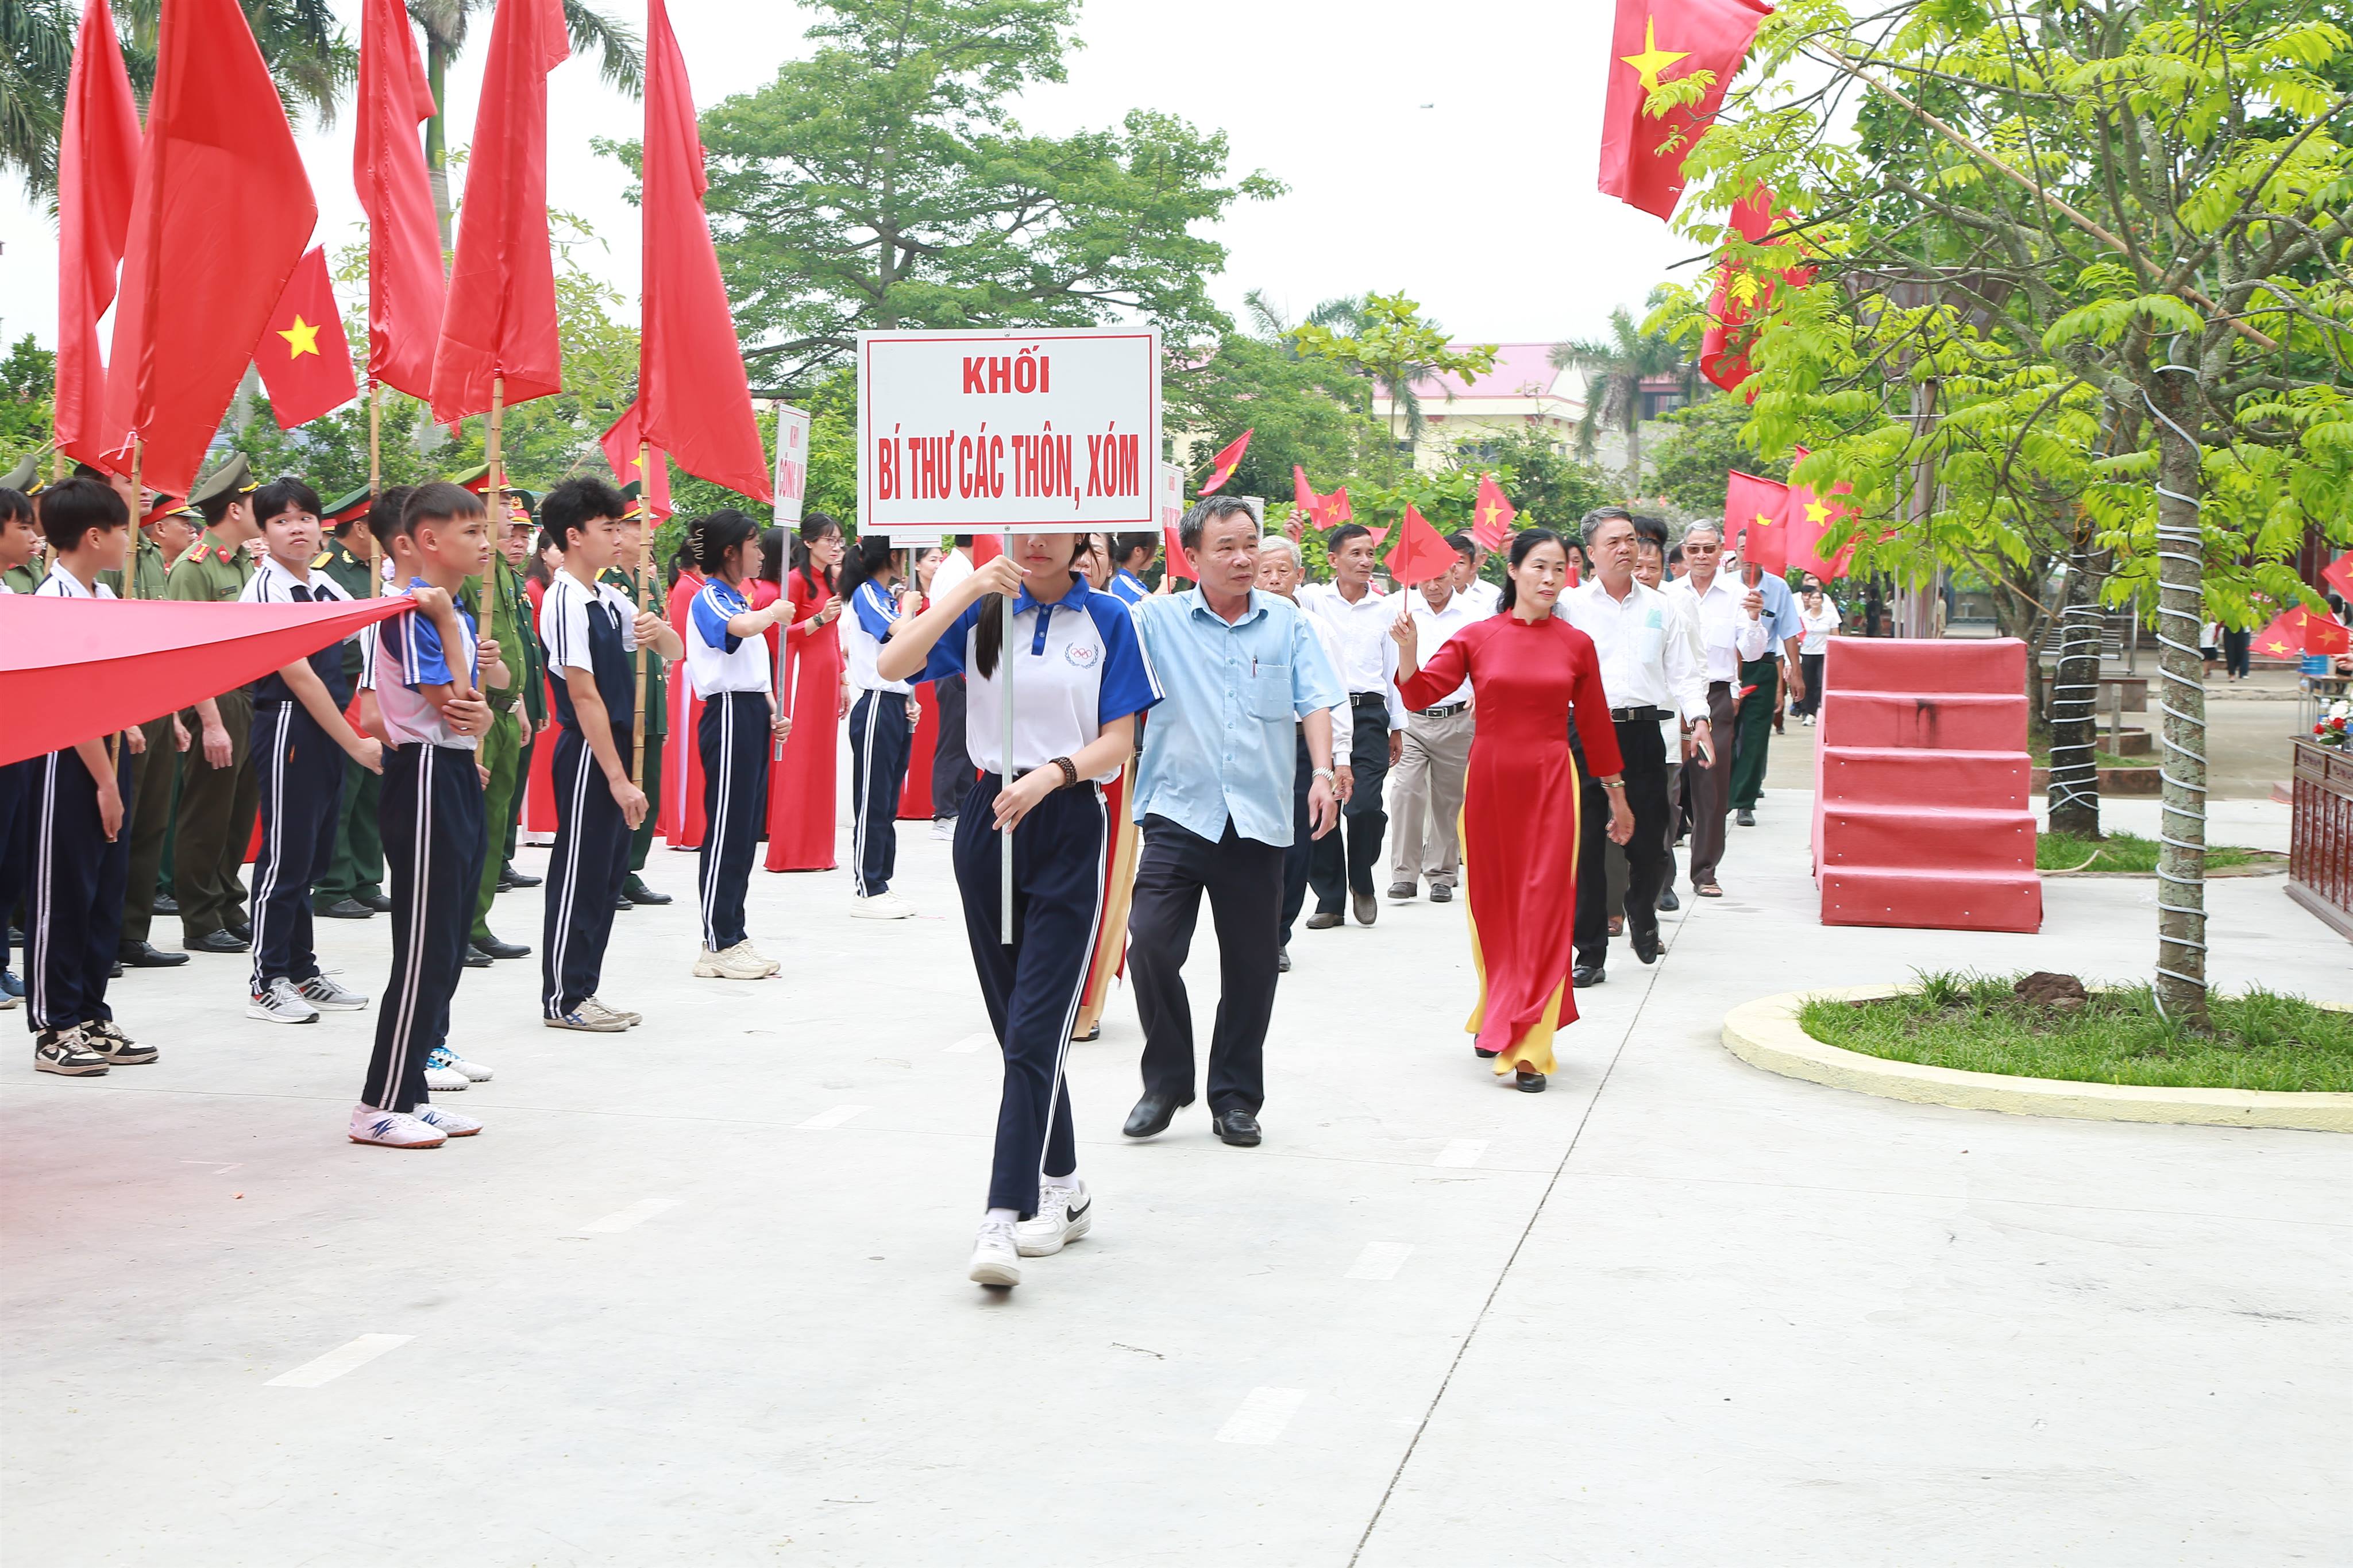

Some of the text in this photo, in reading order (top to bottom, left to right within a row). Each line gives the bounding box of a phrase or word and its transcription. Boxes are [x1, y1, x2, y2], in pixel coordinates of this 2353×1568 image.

[963, 345, 1050, 394] KHỐI
[878, 420, 1140, 510] BÍ THƯ CÁC THÔN, XÓM
